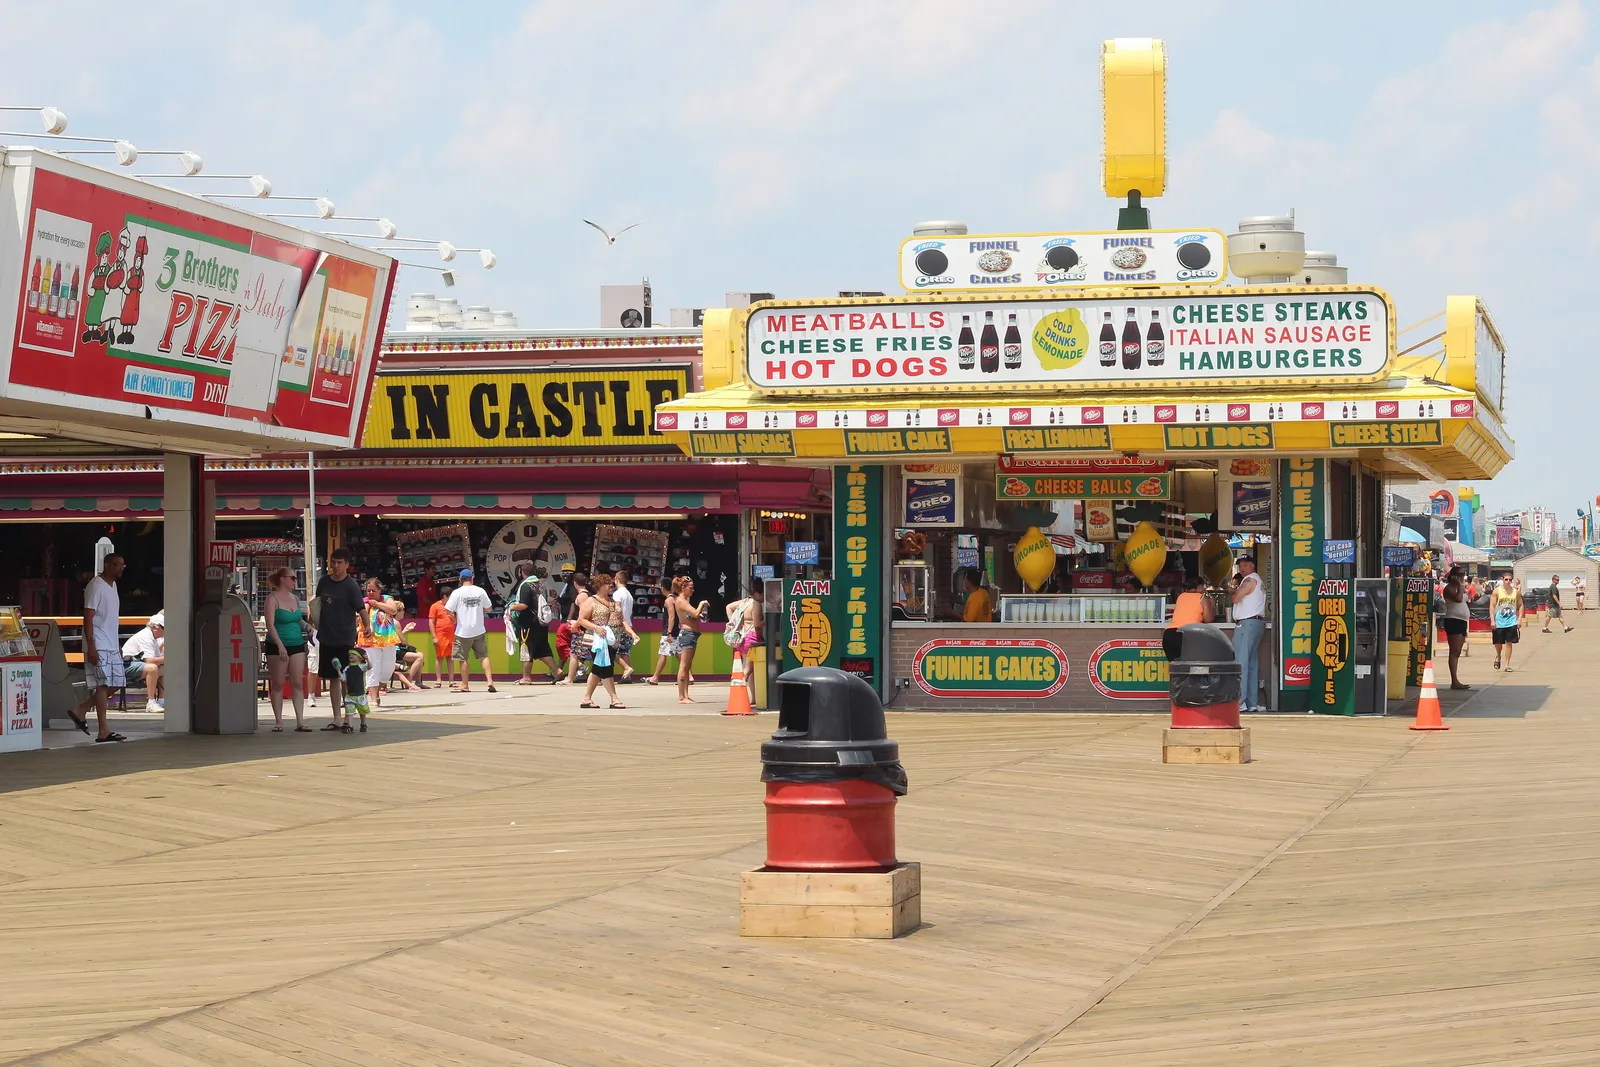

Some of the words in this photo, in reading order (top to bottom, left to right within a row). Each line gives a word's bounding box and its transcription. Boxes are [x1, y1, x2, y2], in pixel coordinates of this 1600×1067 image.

[917, 242, 938, 251] FRIED
[969, 240, 1020, 253] FUNNEL
[1048, 238, 1069, 248] FRIED
[1103, 237, 1155, 250] FUNNEL
[1179, 235, 1200, 244] FRIED
[155, 247, 180, 292] 3
[181, 250, 240, 293] Brothers
[970, 273, 1022, 284] CAKES
[1045, 272, 1085, 284] OREO
[1104, 270, 1156, 281] CAKES
[1177, 269, 1217, 281] OREO
[915, 276, 955, 287] OREO
[244, 272, 290, 333] Italy
[766, 311, 945, 333] MEATBALLS
[1172, 303, 1265, 325] CHEESE
[1275, 300, 1368, 322] STEAKS
[1052, 318, 1073, 334] COLD
[1169, 326, 1255, 347] ITALIAN
[1264, 324, 1372, 344] SAUSAGE
[760, 337, 864, 355] CHEESE
[876, 335, 953, 353] FRIES
[1034, 331, 1084, 360] LEMONADE
[1045, 327, 1077, 347] DRINKS
[766, 359, 836, 380] HOT
[851, 356, 948, 378] DOGS
[1179, 347, 1363, 371] HAMBURGERS
[124, 373, 139, 390] AIR
[141, 374, 193, 399] CONDITIONED
[386, 384, 450, 440] IN
[693, 433, 736, 454] ITALIAN
[737, 432, 791, 453] SAUSAGE
[850, 432, 905, 452] FUNNEL
[906, 430, 948, 450] CAKE
[1006, 429, 1044, 449] FRESH
[1046, 428, 1109, 448] LEMONADE
[1168, 427, 1209, 447] HOT
[1212, 426, 1270, 446] DOGS
[1334, 424, 1389, 444] CHEESE
[1391, 423, 1438, 443] STEAK
[1034, 479, 1085, 495] CHEESE
[1091, 478, 1132, 495] BALLS
[909, 494, 952, 510] OREO
[1290, 458, 1314, 557] CHEESE
[606, 528, 620, 536] ONE
[621, 530, 636, 539] WIN
[636, 532, 659, 541] CHOICE
[212, 545, 232, 561] ATM
[788, 546, 799, 554] Get
[800, 543, 816, 552] Cash
[846, 536, 867, 577] CUT
[1326, 544, 1336, 552] Get
[1337, 542, 1353, 550] Cash
[493, 554, 507, 563] POP
[554, 553, 568, 562] MOM
[207, 569, 220, 577] ATM
[1079, 575, 1104, 584] Coca-Cola
[790, 580, 831, 596] ATM
[1317, 580, 1348, 595] ATM
[1407, 580, 1429, 592] ATM
[1291, 568, 1315, 654] STEAK
[1318, 598, 1346, 616] OREO
[789, 600, 799, 648] ITALIAN
[846, 587, 867, 655] FRIES
[230, 615, 243, 683] ATM
[926, 656, 993, 681] FUNNEL
[995, 656, 1056, 681] CAKES
[1324, 617, 1339, 705] COOKIES
[1101, 660, 1170, 682] FRENCH
[11, 718, 33, 730] PIZZA
